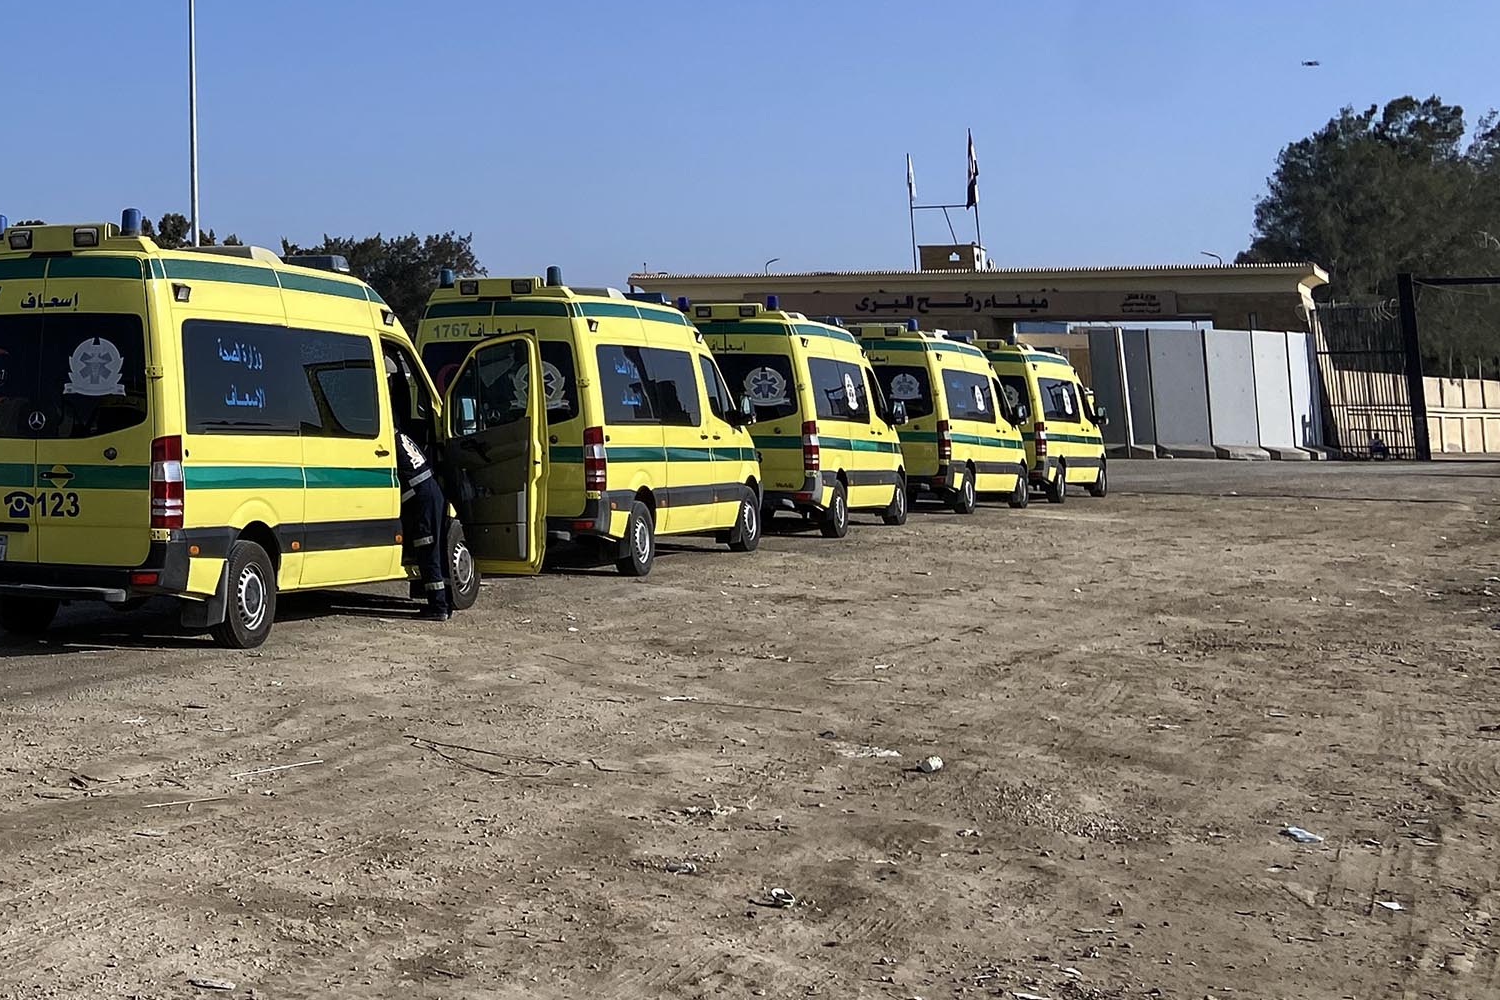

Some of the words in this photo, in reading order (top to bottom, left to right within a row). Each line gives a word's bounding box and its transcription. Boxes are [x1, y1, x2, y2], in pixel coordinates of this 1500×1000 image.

[20, 292, 79, 311] إسعاف
[917, 291, 982, 313] رفح
[434, 323, 469, 339] 1767
[36, 492, 80, 517] 123
